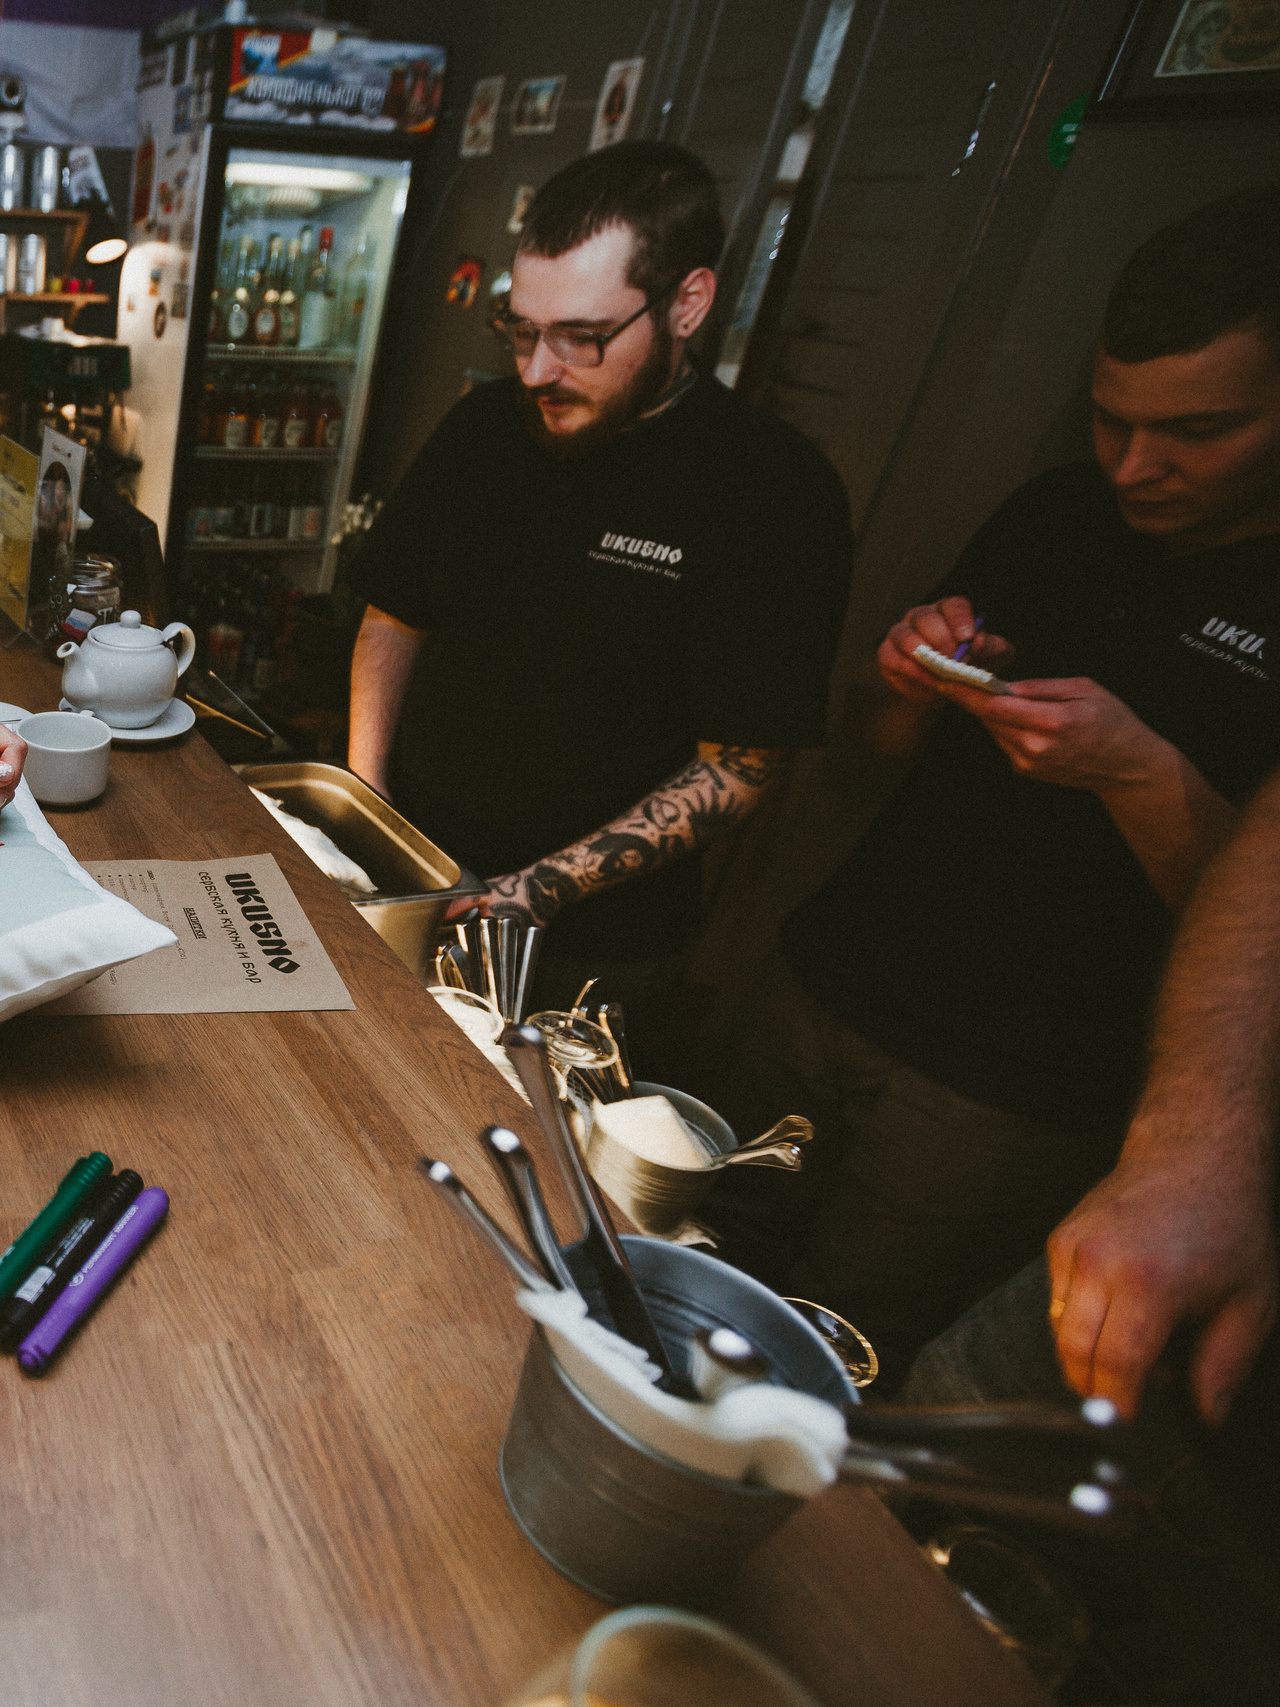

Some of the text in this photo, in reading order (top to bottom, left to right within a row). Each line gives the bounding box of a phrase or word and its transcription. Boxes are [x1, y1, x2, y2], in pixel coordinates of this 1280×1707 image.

[600, 531, 683, 565] UKUSNO
[1202, 616, 1267, 654] UKU
[225, 872, 301, 974] UKUSNO
[81, 1204, 139, 1274] PERMANENT MARKER
